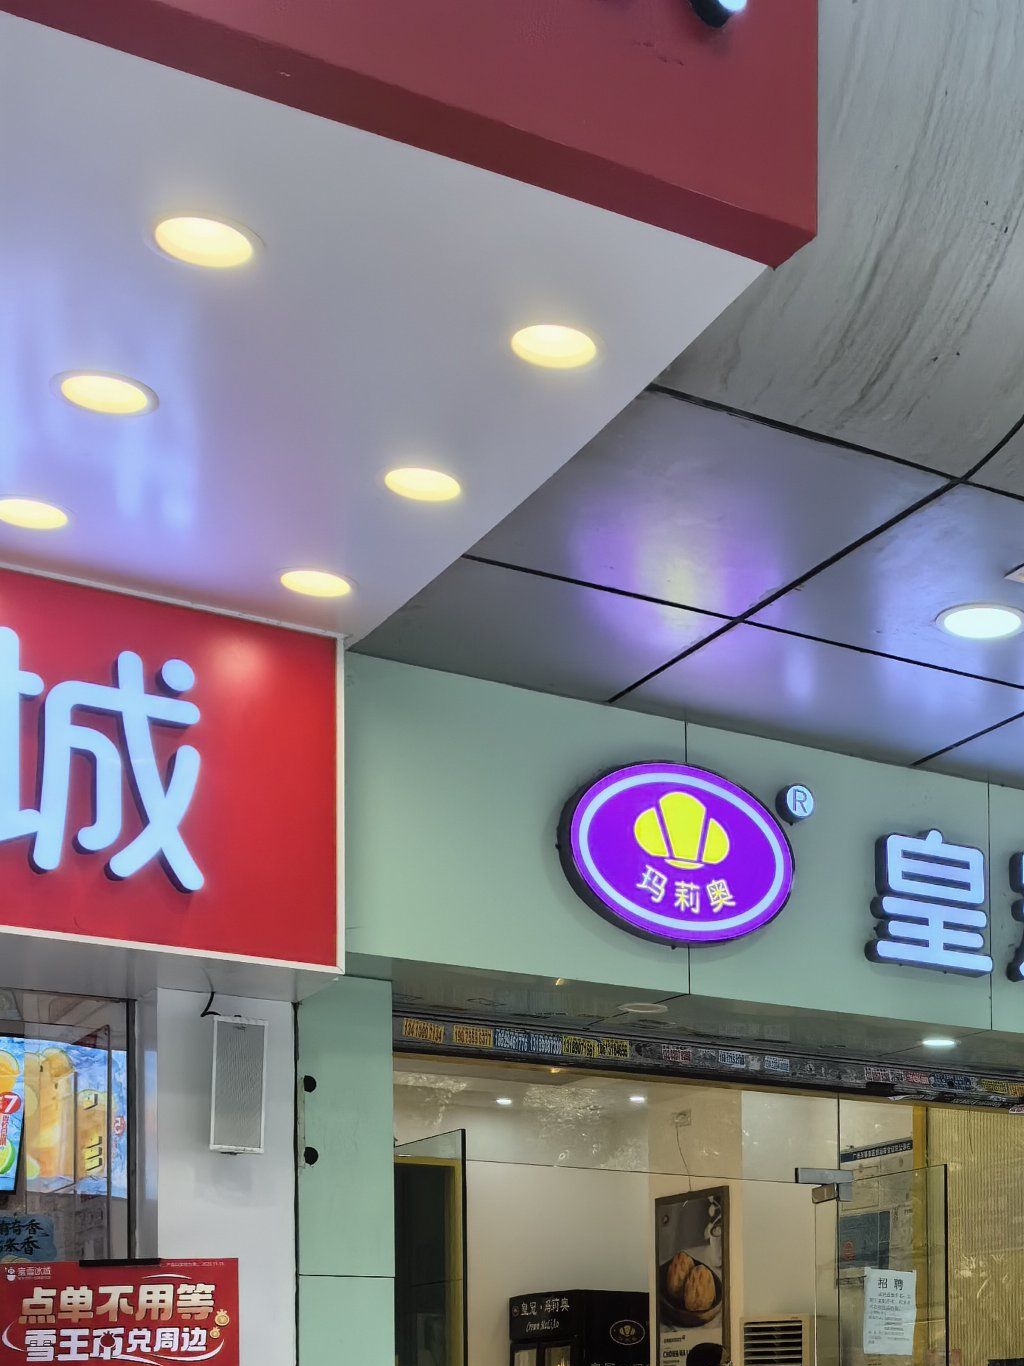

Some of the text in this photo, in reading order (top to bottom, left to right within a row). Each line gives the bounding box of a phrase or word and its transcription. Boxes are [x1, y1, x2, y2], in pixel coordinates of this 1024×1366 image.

[636, 864, 736, 914] 玛莉奥
[18, 1284, 216, 1324] 点单不用等
